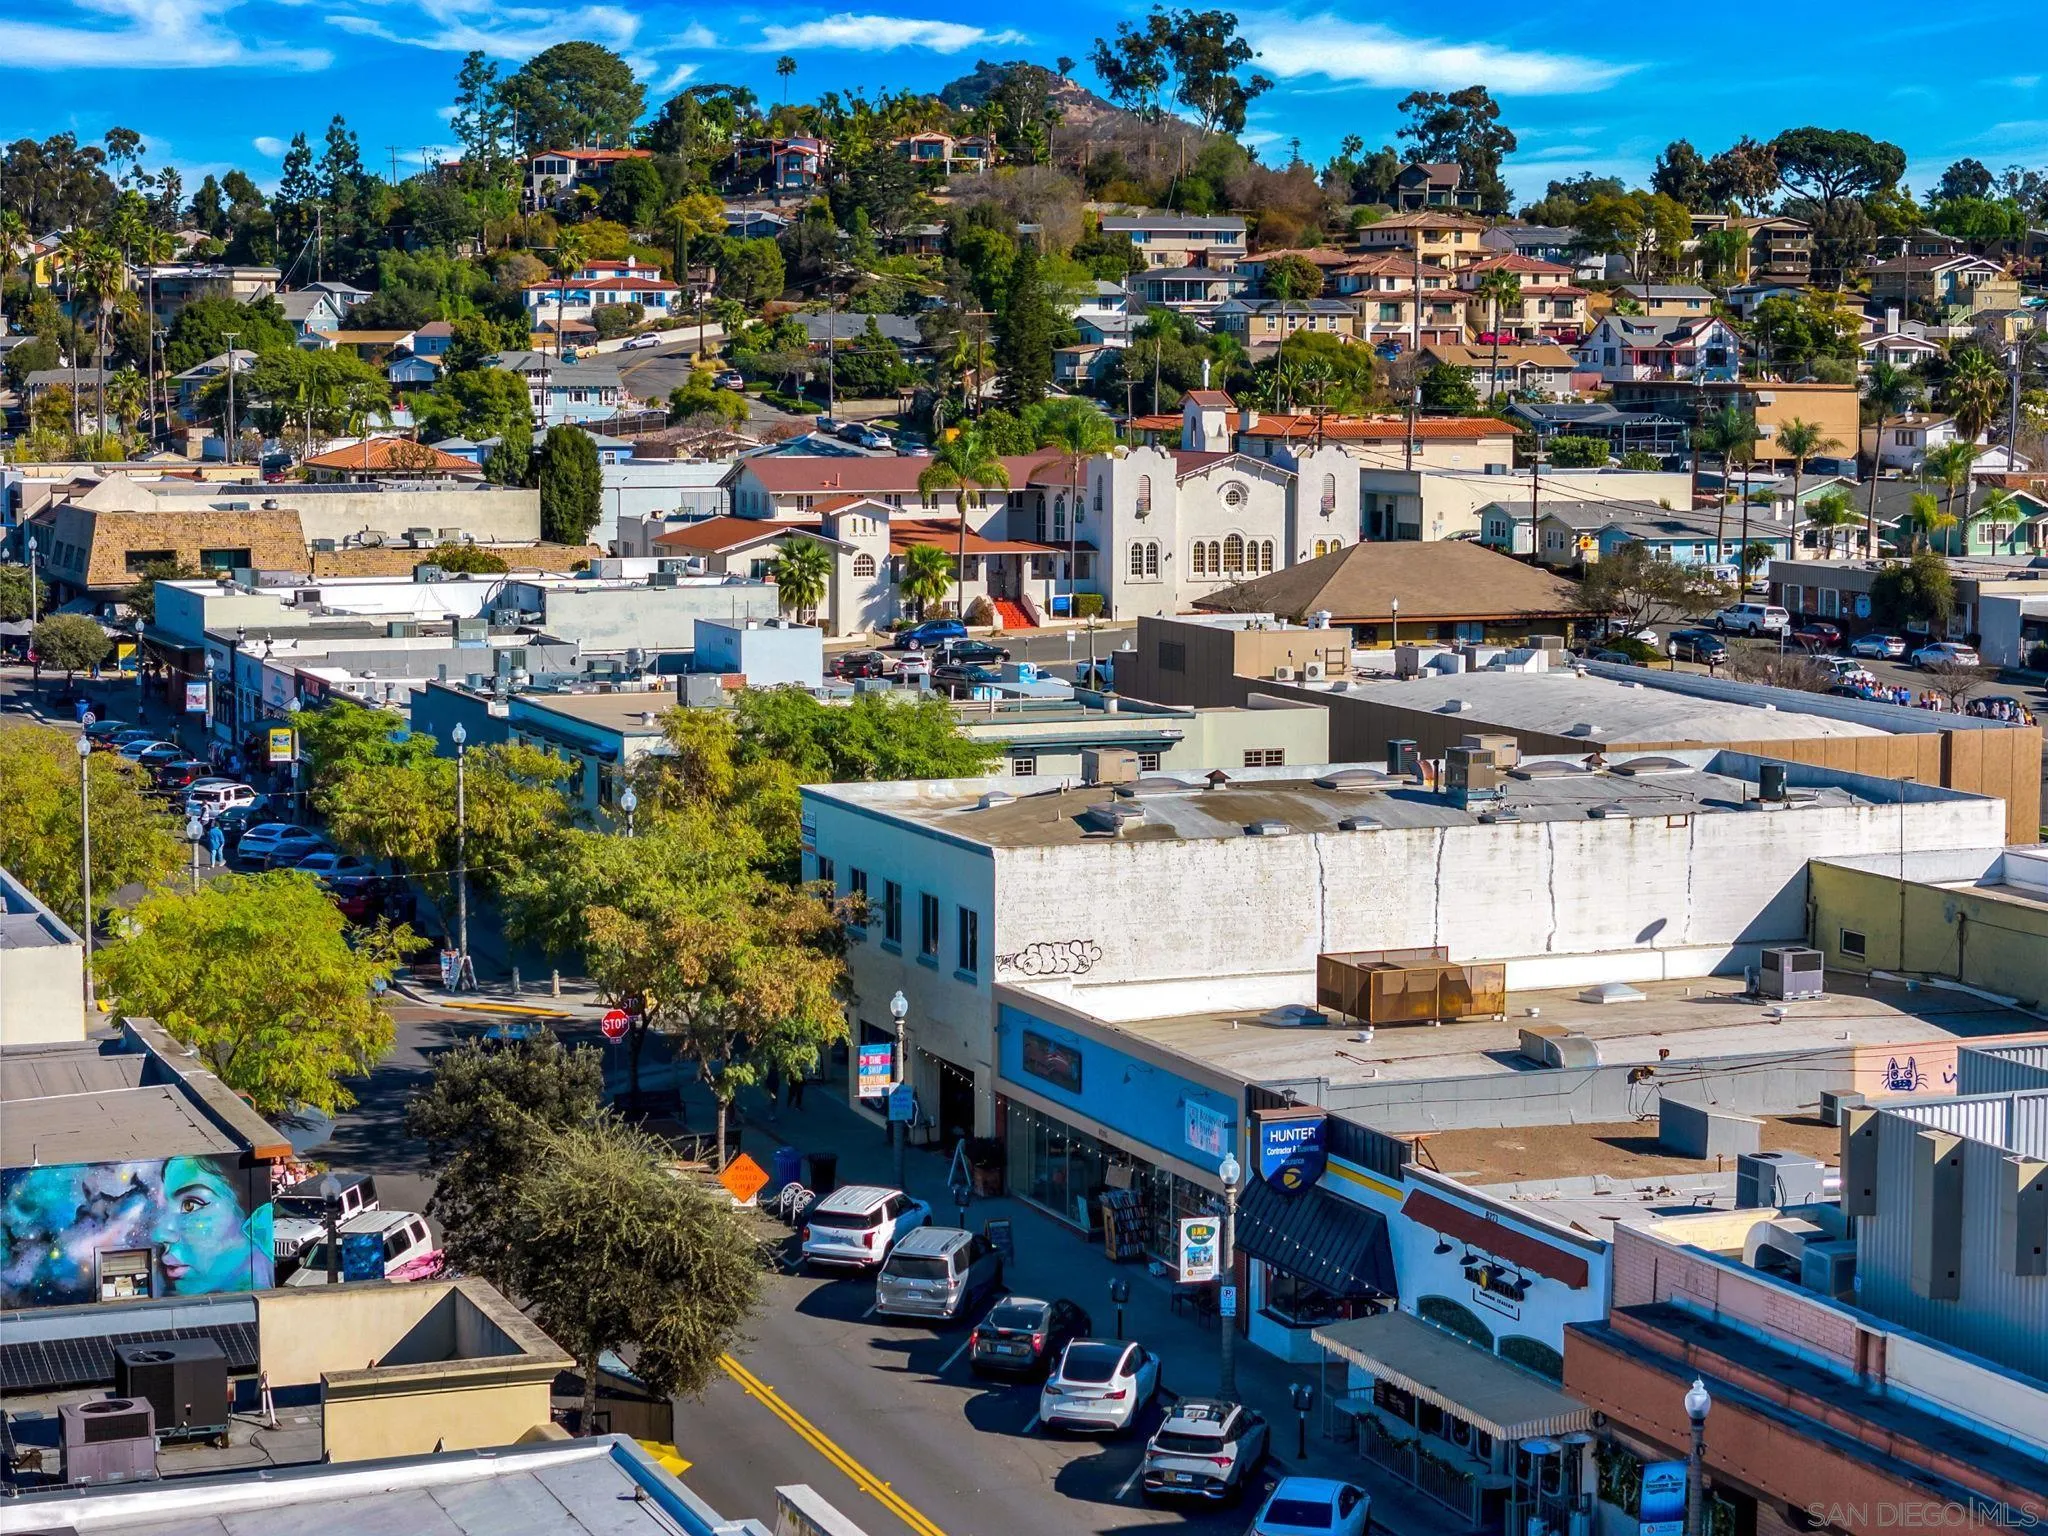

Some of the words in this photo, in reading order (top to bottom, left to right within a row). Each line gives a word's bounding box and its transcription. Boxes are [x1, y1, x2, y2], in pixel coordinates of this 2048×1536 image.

[603, 1018, 628, 1031] STOP
[1270, 1127, 1316, 1142] HUNTER
[1266, 1146, 1292, 1156] Contractor
